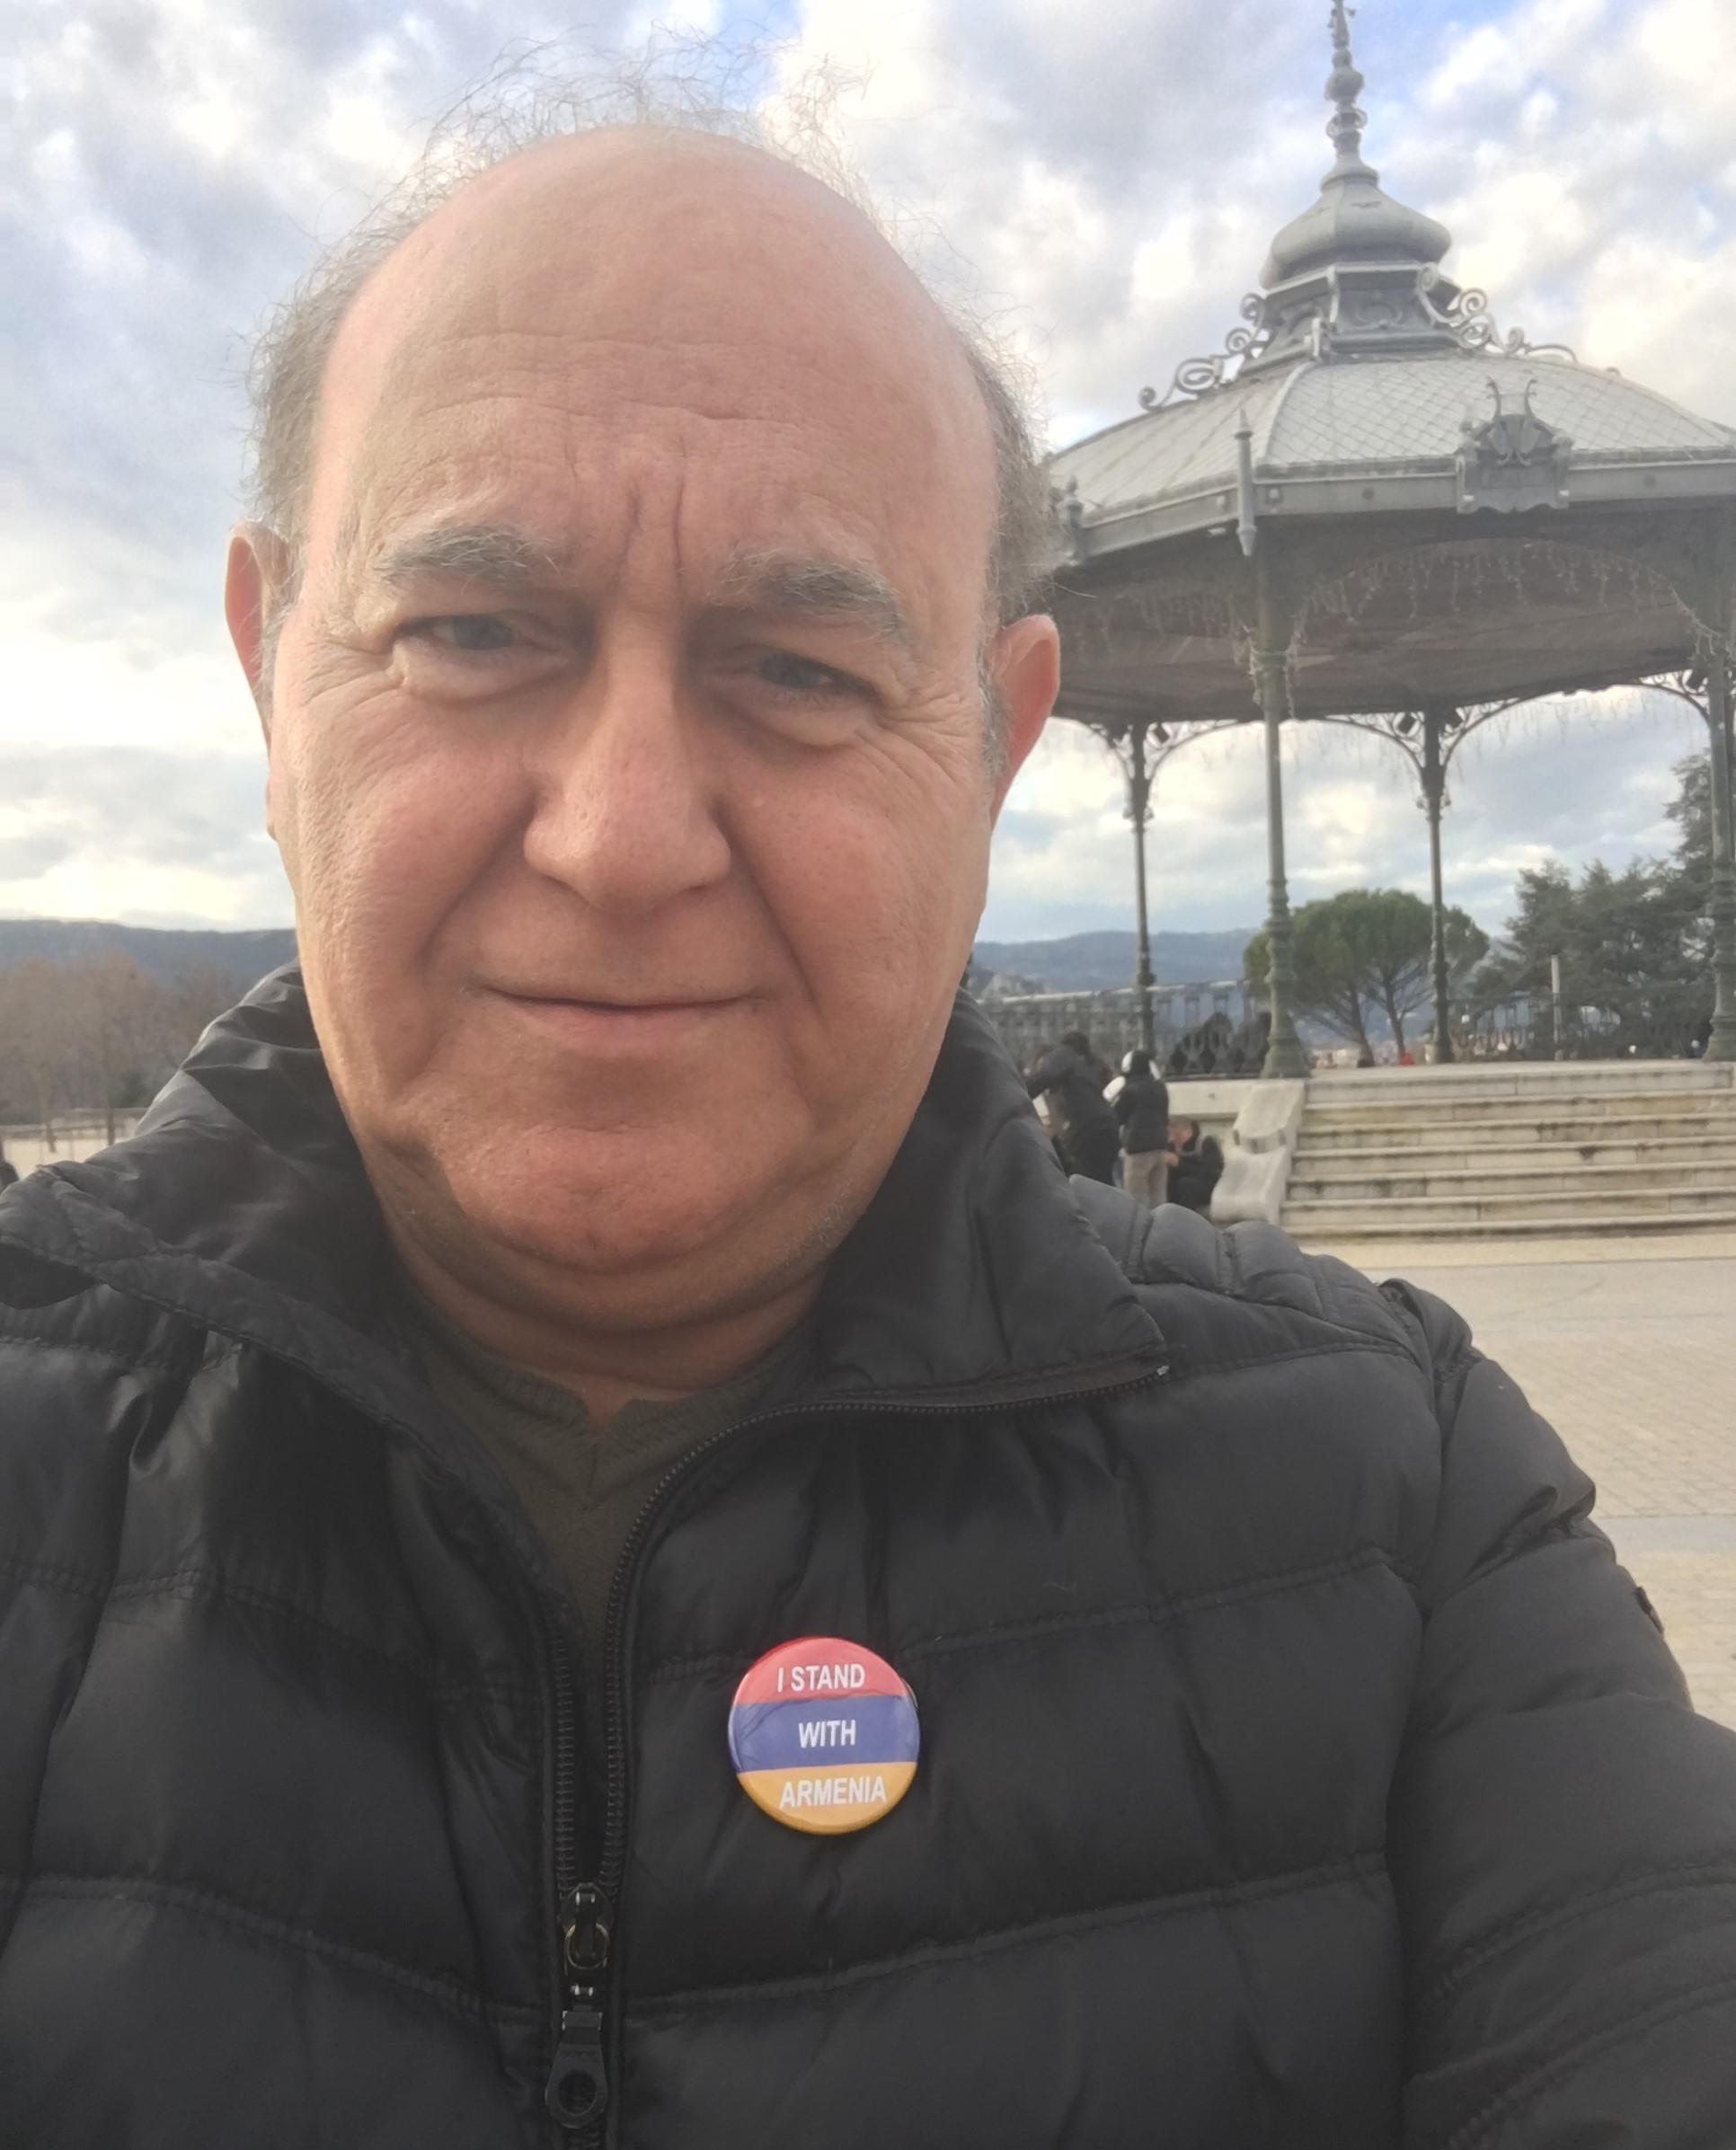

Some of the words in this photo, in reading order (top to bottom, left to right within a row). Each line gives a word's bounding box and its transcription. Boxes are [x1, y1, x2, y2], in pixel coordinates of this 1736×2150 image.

[777, 1667, 784, 1693] I
[791, 1664, 865, 1692] STAND
[798, 1720, 857, 1748] WITH
[779, 1776, 887, 1809] ARMENIA
